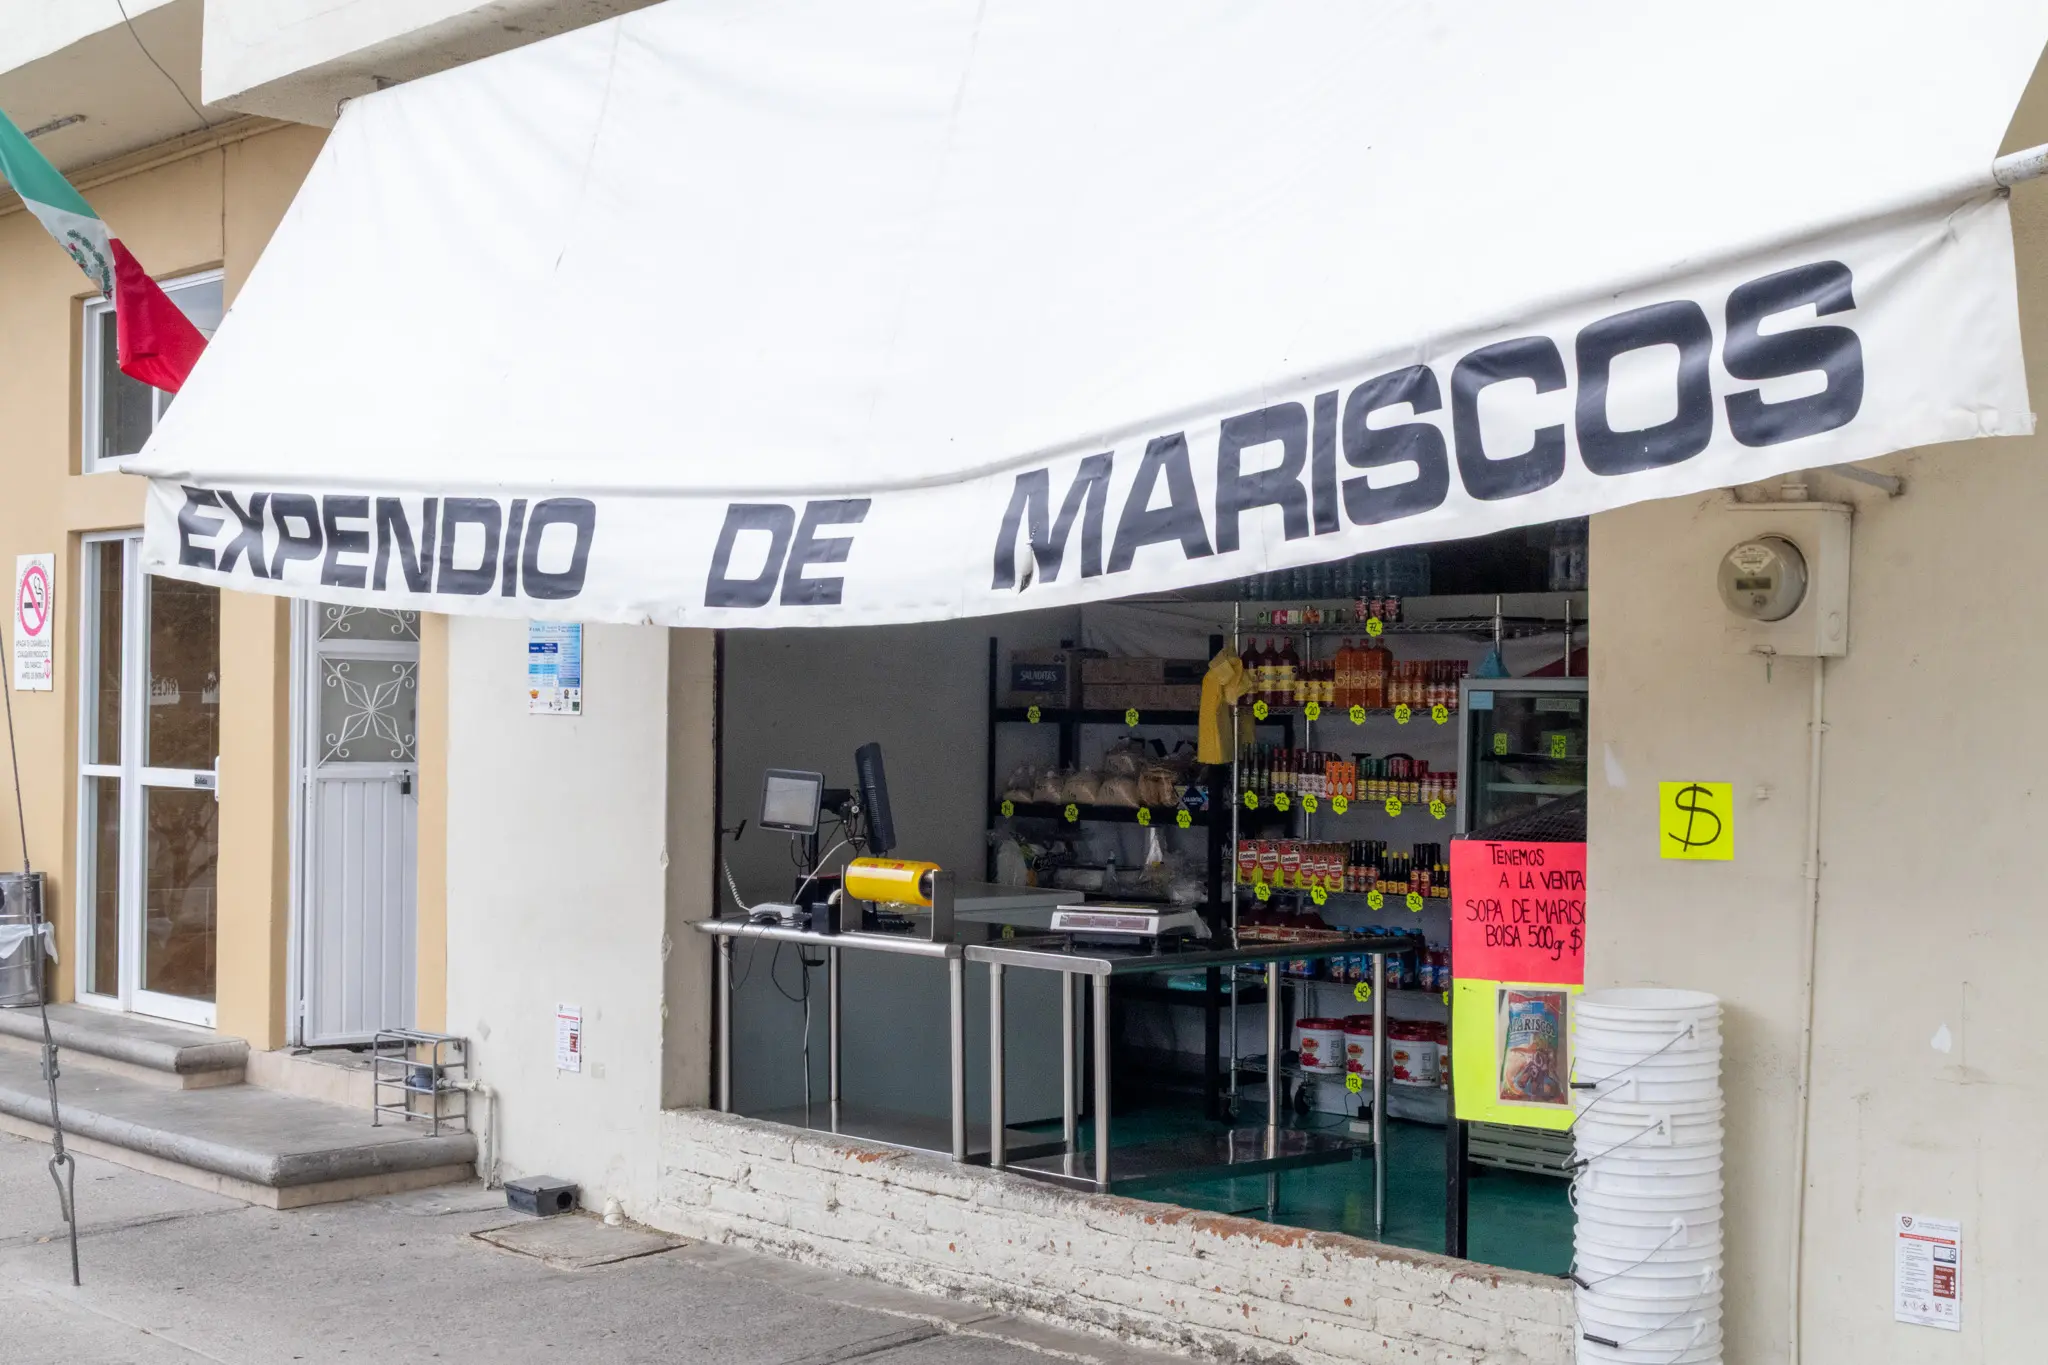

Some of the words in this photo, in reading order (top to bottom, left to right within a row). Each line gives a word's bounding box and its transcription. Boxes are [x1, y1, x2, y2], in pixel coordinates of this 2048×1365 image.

[178, 485, 597, 601] EXPENDIO
[704, 497, 872, 608] DE
[993, 259, 1865, 592] MARISCOS
[1668, 784, 1722, 853] $
[1485, 843, 1545, 866] TENEMOS
[1499, 871, 1509, 889] A
[1519, 871, 1534, 889] LA
[1540, 870, 1586, 890] VENTA
[1466, 899, 1504, 922] SOPA
[1512, 899, 1530, 924] DE
